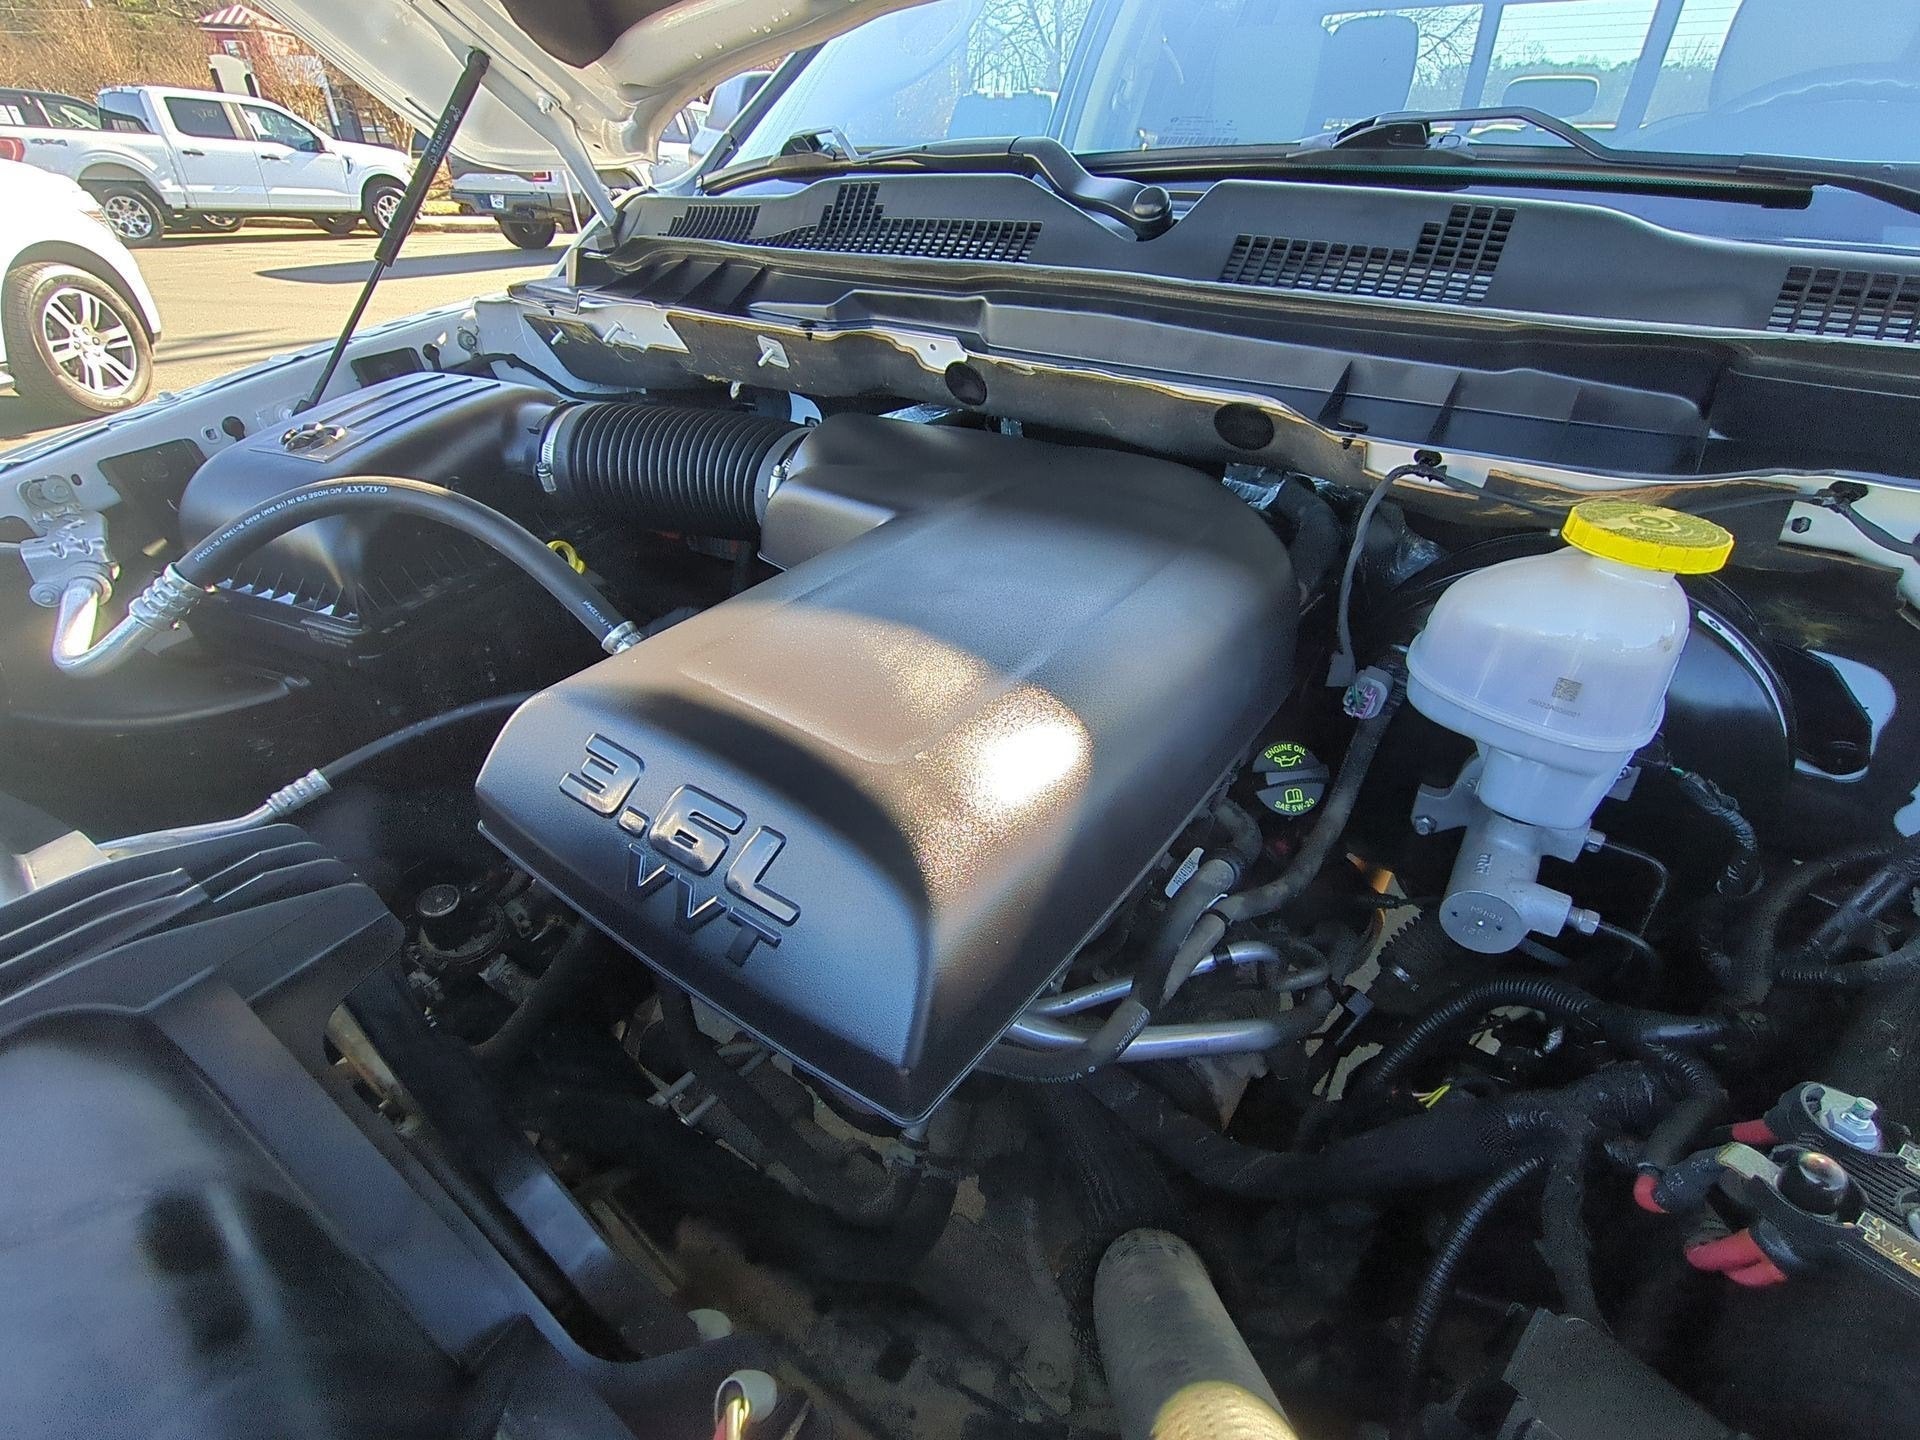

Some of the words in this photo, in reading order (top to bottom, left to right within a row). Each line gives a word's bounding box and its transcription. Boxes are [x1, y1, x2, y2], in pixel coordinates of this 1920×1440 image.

[308, 489, 329, 499] HOSE
[330, 487, 343, 495] A/C
[345, 485, 388, 494] GALAXY
[1264, 744, 1293, 759] ENGINE
[1293, 745, 1307, 757] OIL
[1274, 800, 1291, 812] SAE
[1291, 797, 1315, 812] 5W-20
[558, 732, 801, 926] 3.6L
[625, 843, 783, 967] VVT
